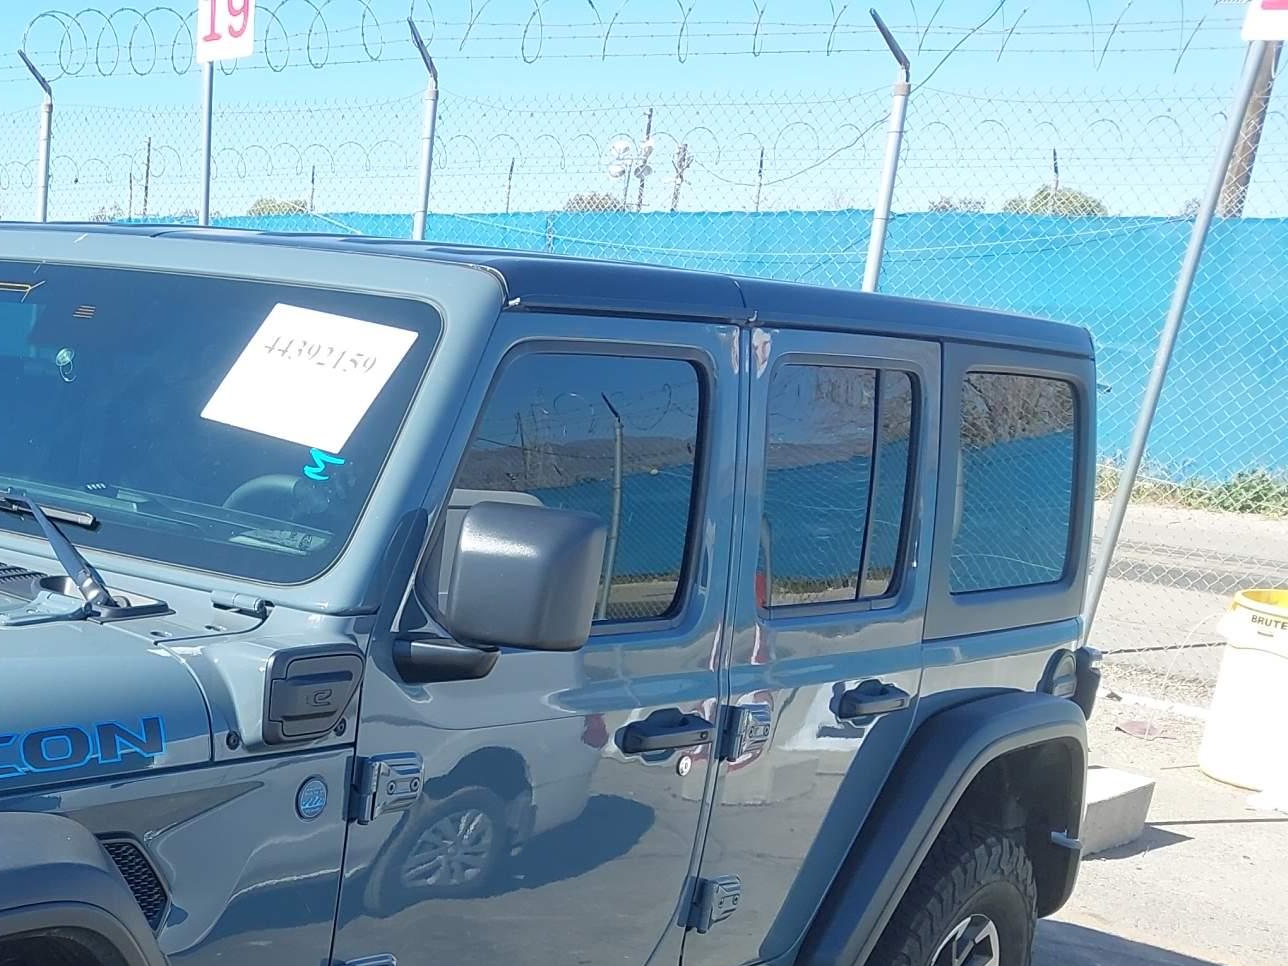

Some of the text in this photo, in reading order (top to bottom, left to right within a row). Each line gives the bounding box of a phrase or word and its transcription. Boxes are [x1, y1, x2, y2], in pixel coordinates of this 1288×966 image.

[203, 0, 249, 42] 19
[264, 335, 377, 374] 44392159
[1250, 614, 1288, 631] BRUTE
